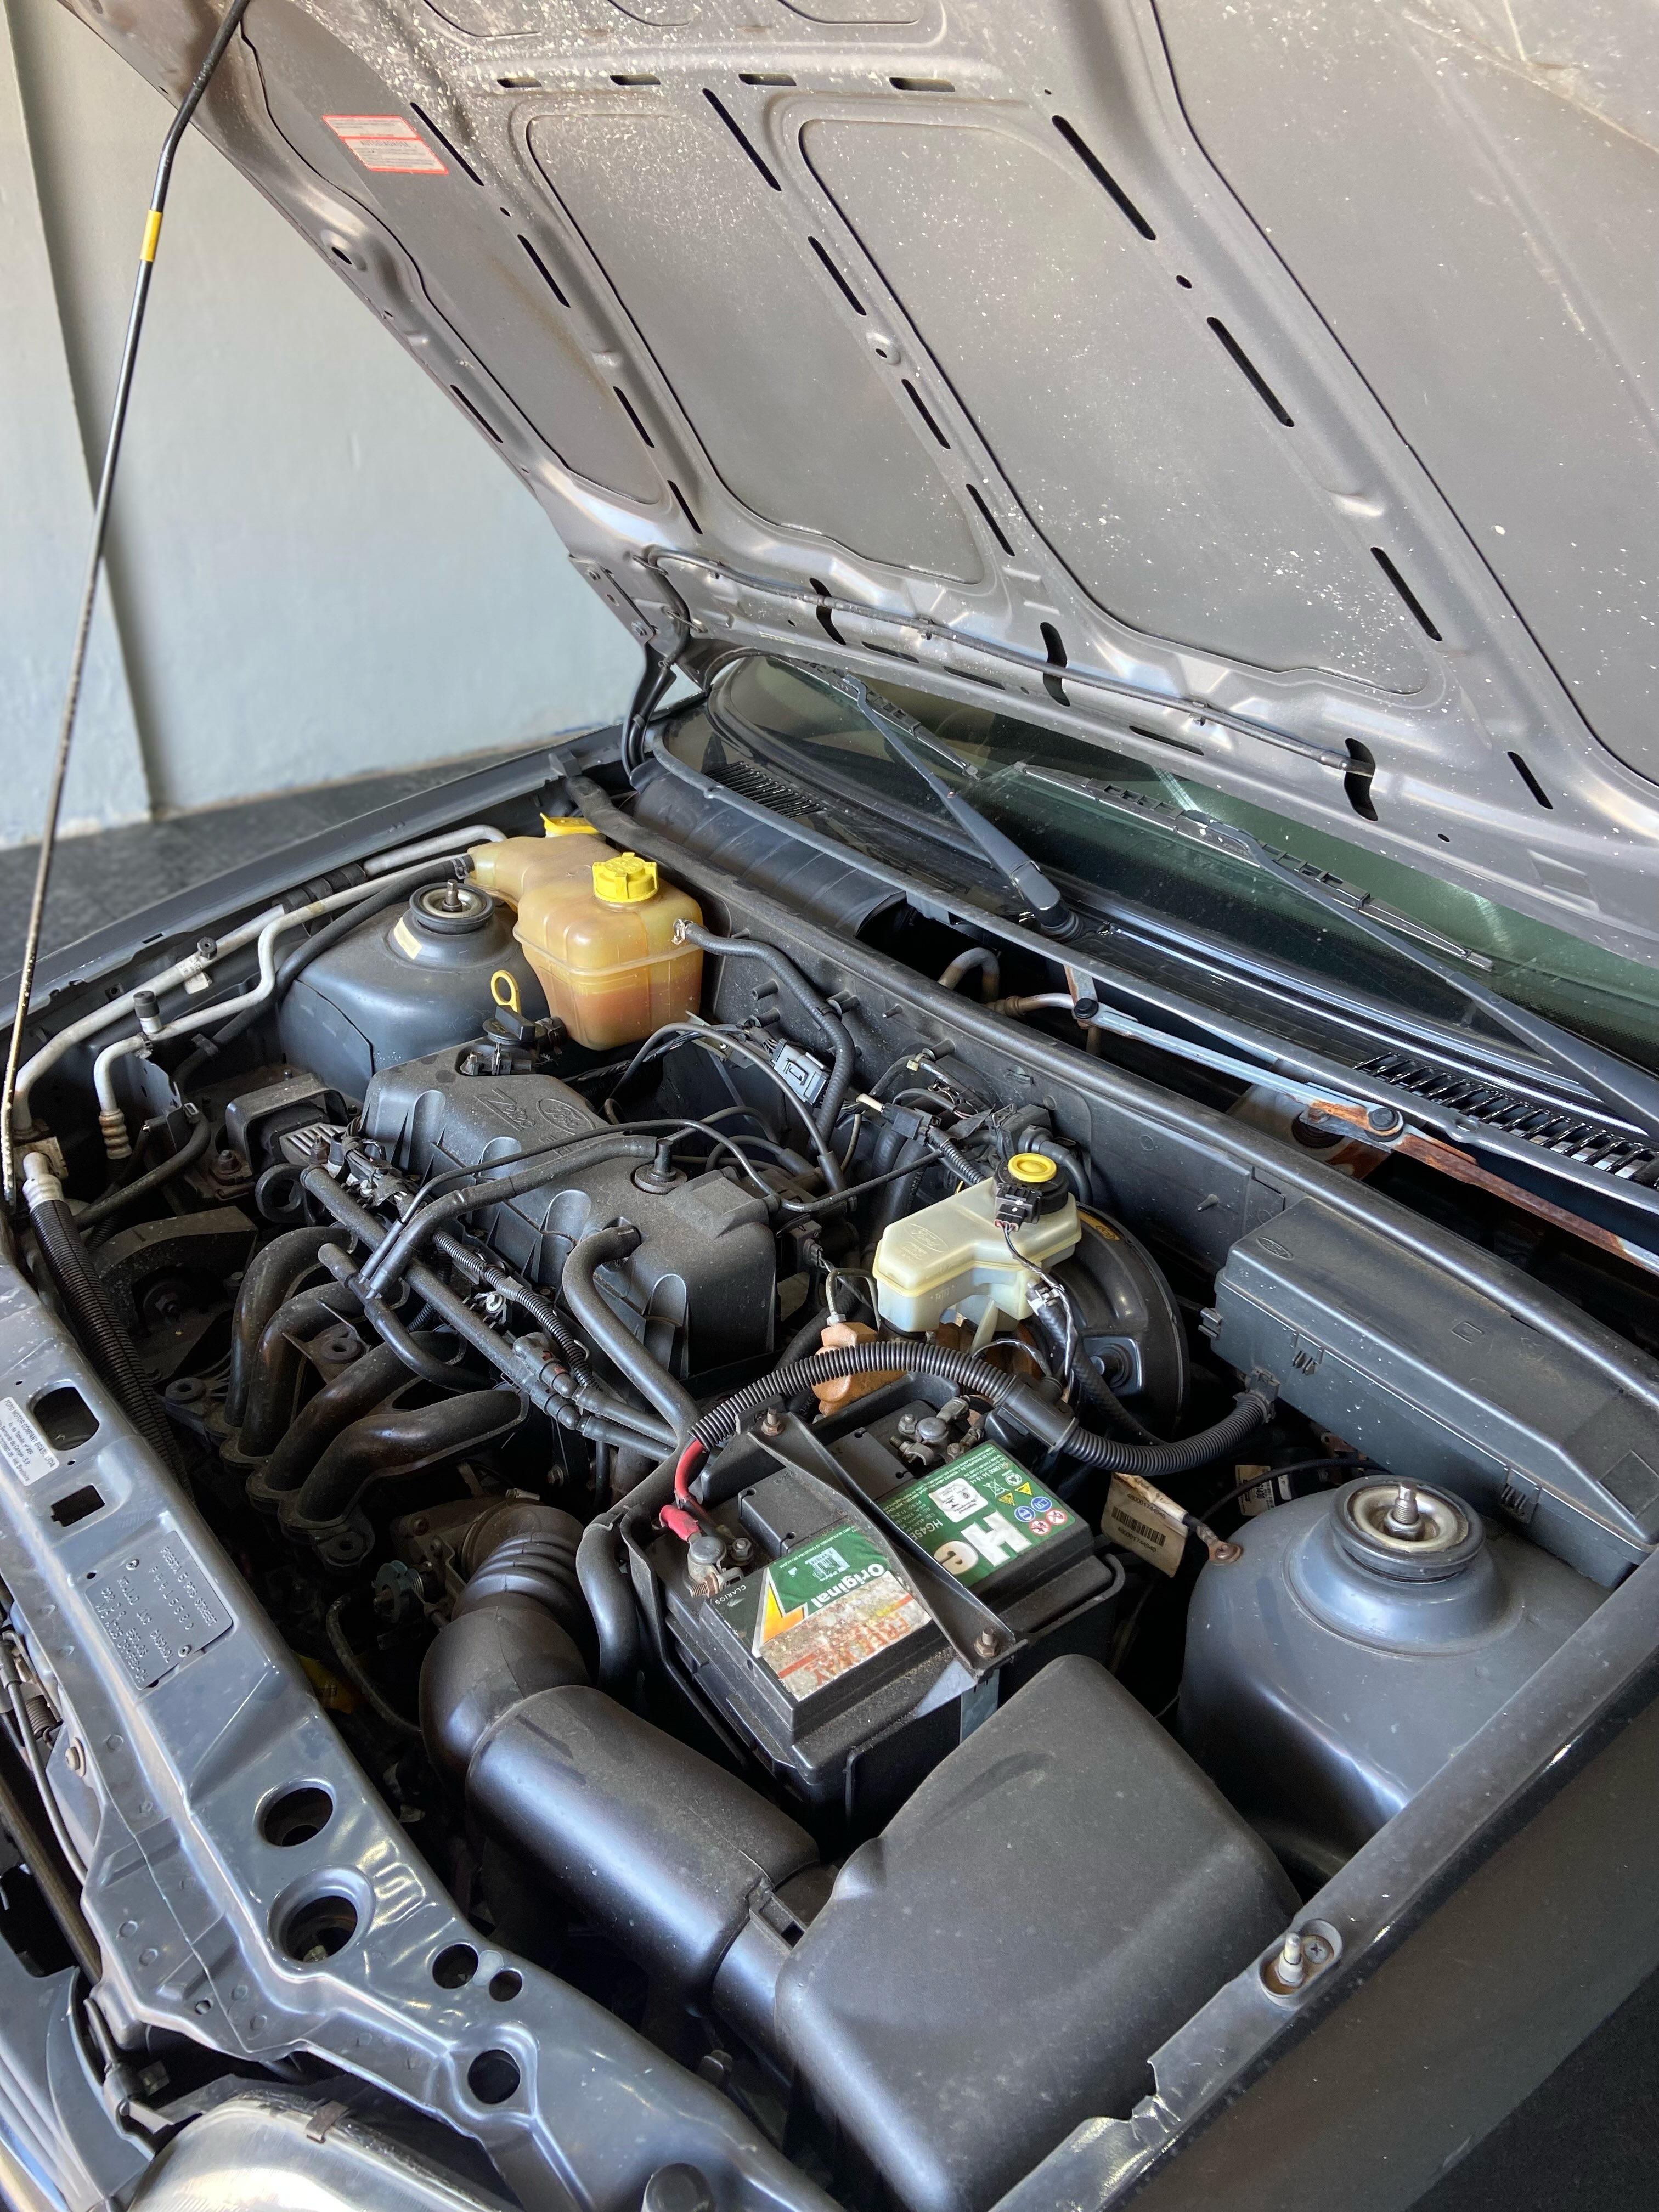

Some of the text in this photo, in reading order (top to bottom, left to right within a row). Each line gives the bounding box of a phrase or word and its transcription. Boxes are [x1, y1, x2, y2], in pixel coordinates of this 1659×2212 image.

[473, 1088, 537, 1131] Zetec
[910, 1229, 941, 1248] Ford
[4, 1399, 15, 1411] FORD
[11, 1409, 25, 1425] MOTOR
[20, 1423, 38, 1443] COMPANY
[987, 1465, 1000, 1474] 0800
[159, 1545, 218, 1627] FIESTA 5 PTS STREET
[715, 1584, 747, 1605] CLARIOS
[810, 1563, 884, 1609] Original
[148, 1628, 176, 1663] GASOHOL
